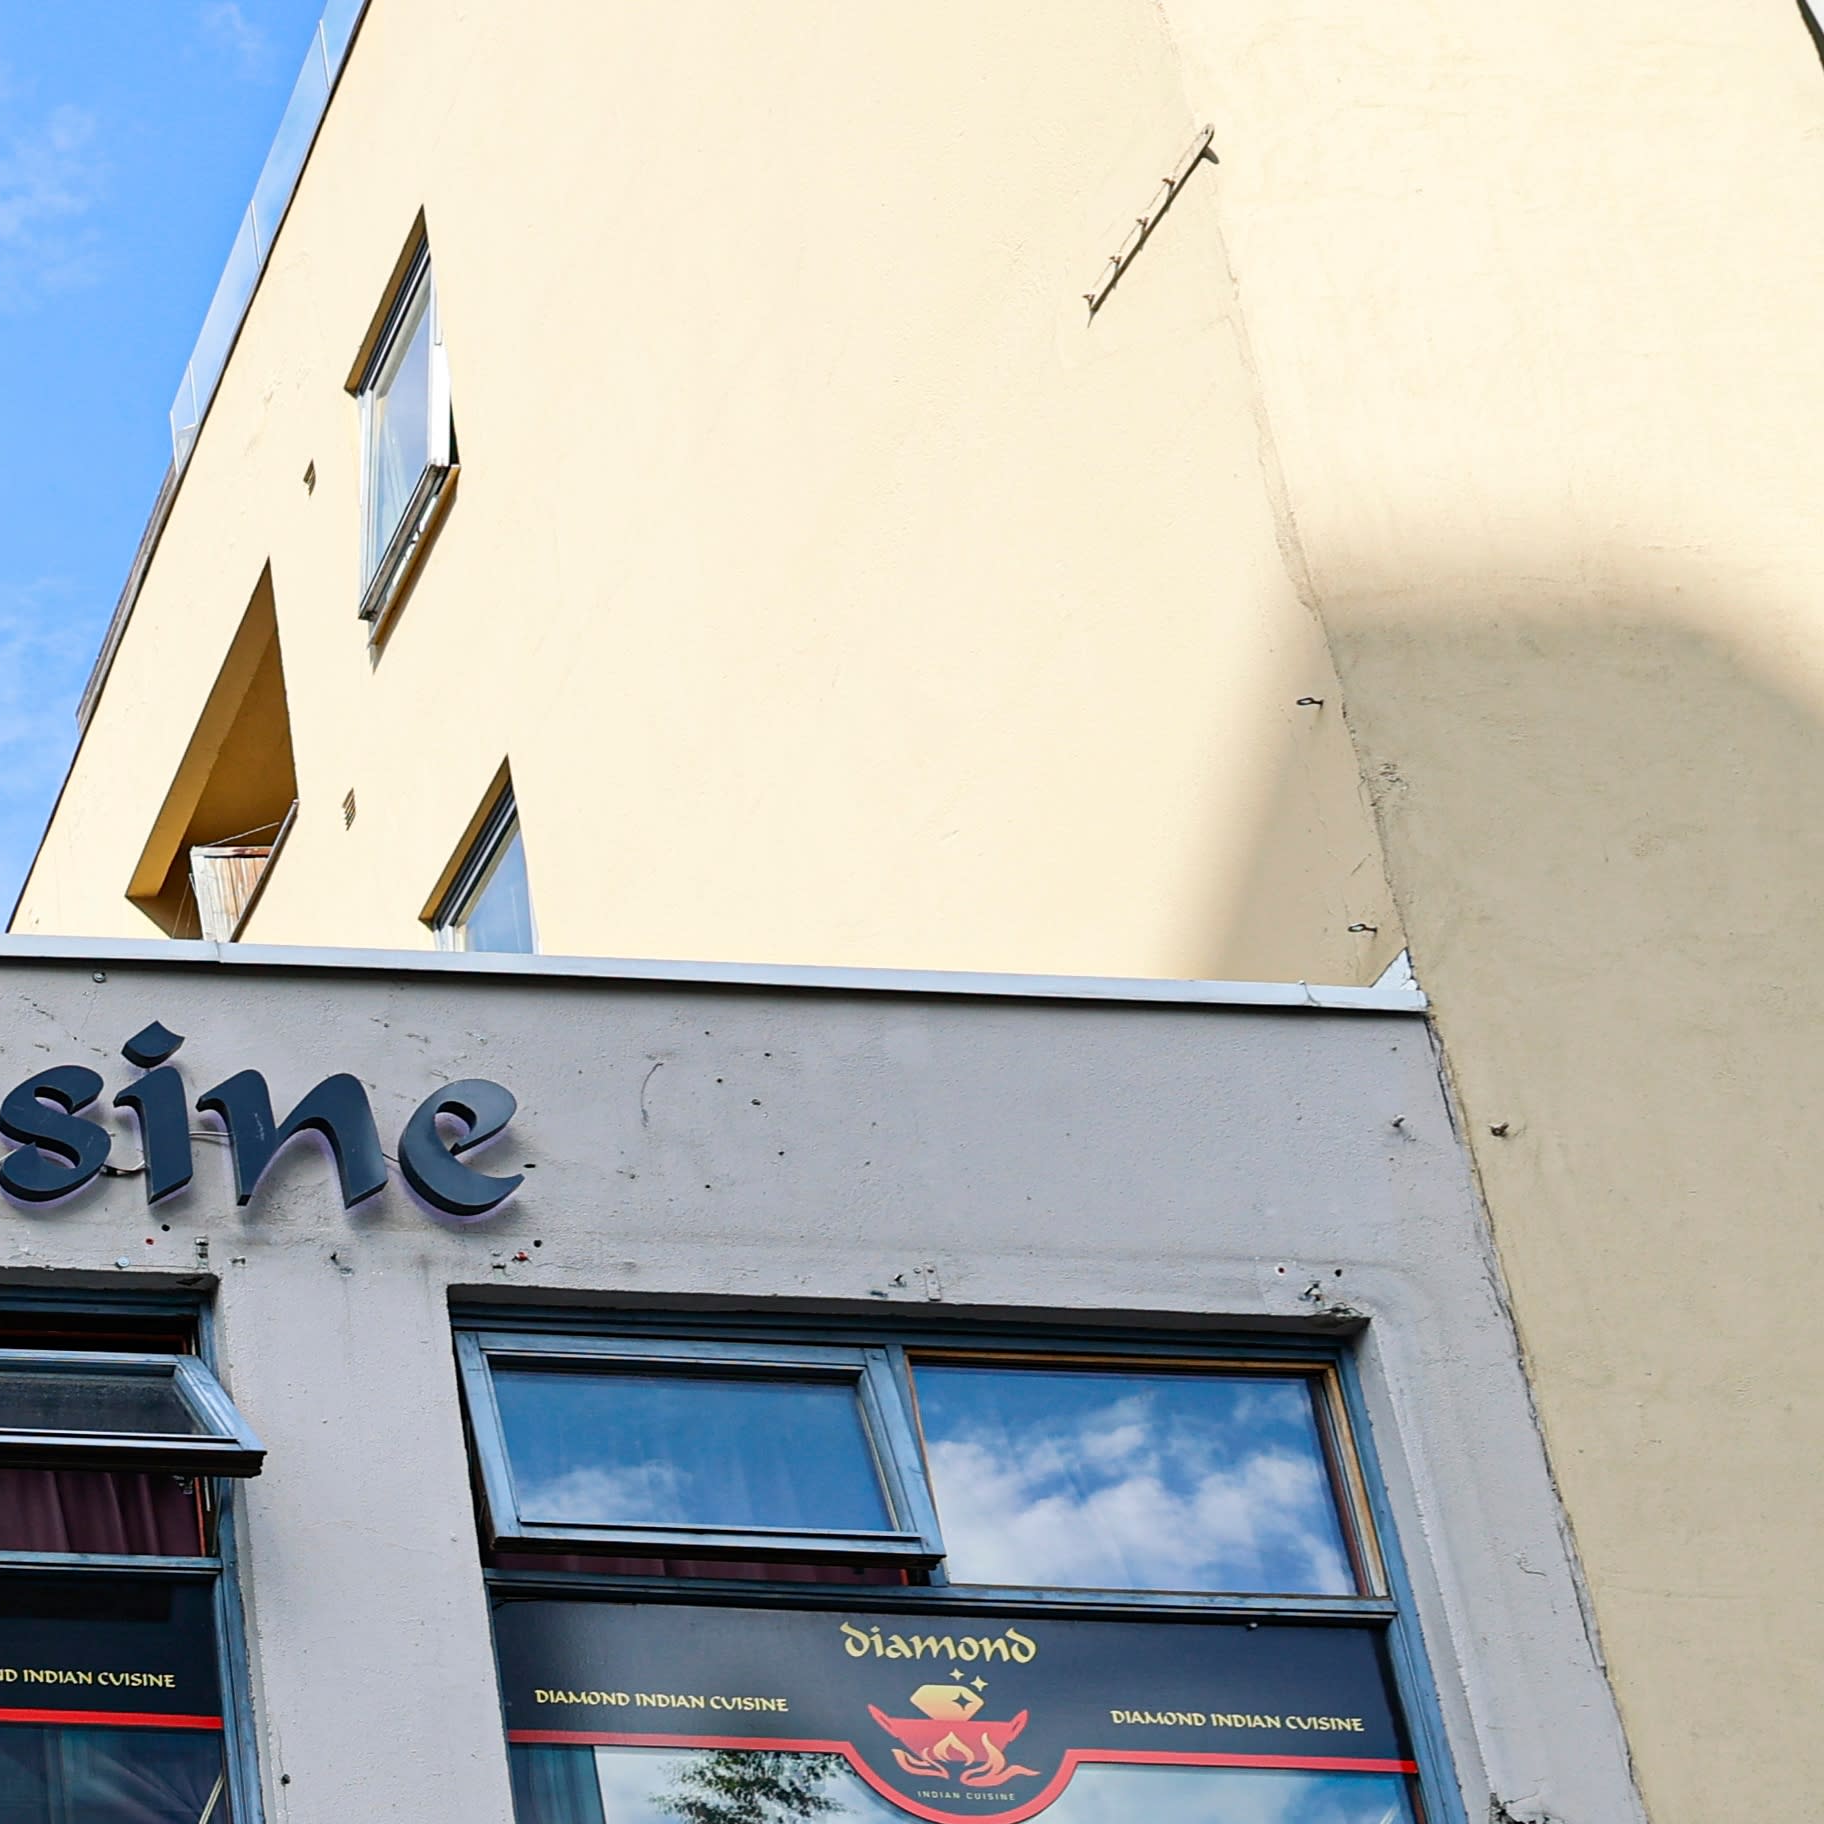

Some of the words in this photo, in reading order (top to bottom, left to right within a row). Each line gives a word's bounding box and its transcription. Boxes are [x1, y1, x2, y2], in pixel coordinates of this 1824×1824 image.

[839, 1621, 1036, 1664] diamond
[23, 1669, 93, 1685] INDIAN
[97, 1671, 176, 1688] CUISINE
[534, 1689, 631, 1707] DIAMOND
[634, 1693, 705, 1709] INDIAN
[709, 1695, 789, 1712] CUISINE
[1109, 1710, 1207, 1727] DIAMOND
[1210, 1713, 1282, 1729] INDIAN
[1285, 1715, 1365, 1732] CUISINE
[917, 1790, 961, 1799] INDIAN
[965, 1792, 1016, 1801] CUISINE
